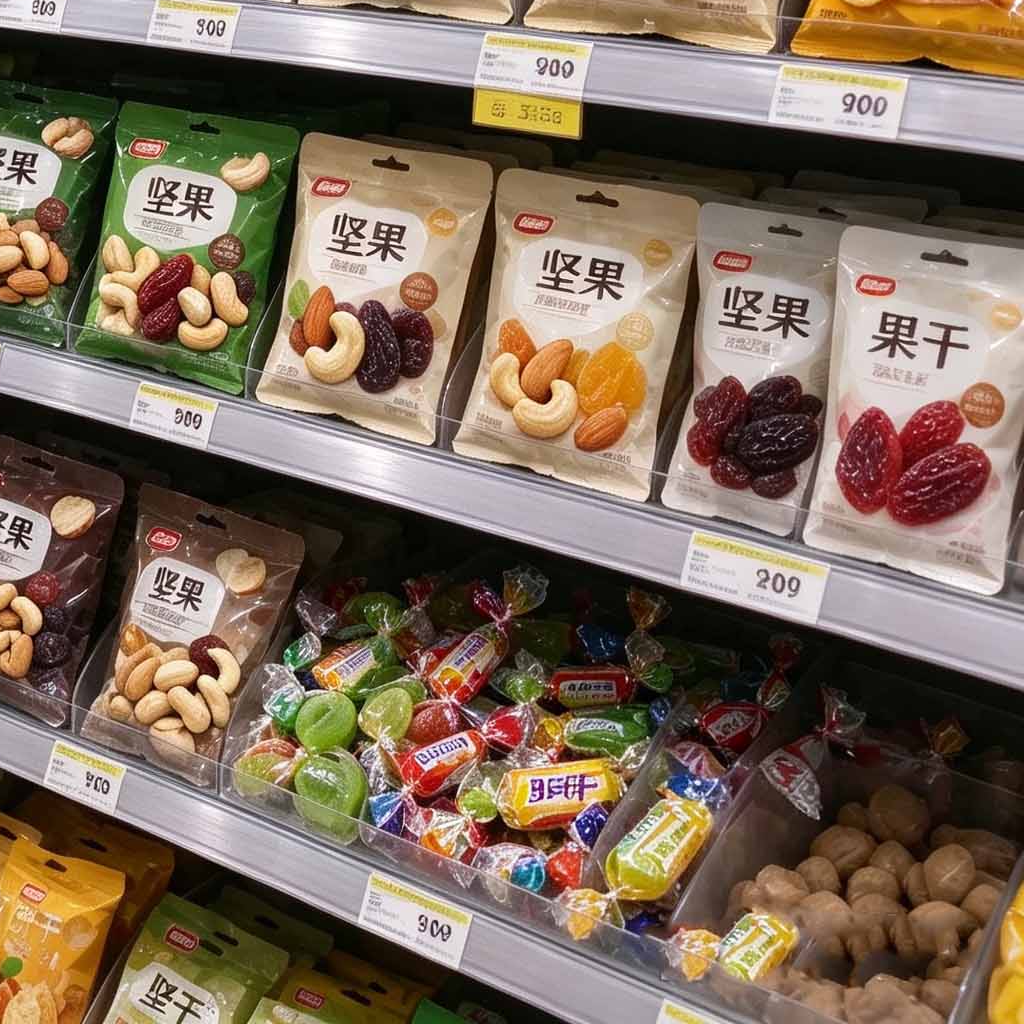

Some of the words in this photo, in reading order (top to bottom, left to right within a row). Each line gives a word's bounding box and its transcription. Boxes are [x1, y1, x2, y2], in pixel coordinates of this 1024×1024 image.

[143, 177, 214, 222] 坚果
[326, 214, 406, 263] 坚果
[536, 249, 625, 300] 坚果
[718, 287, 810, 338] 坚果
[869, 311, 969, 370] 果干
[148, 567, 204, 611] 坚果
[756, 568, 801, 598] 209
[139, 973, 204, 1024] 坚干
